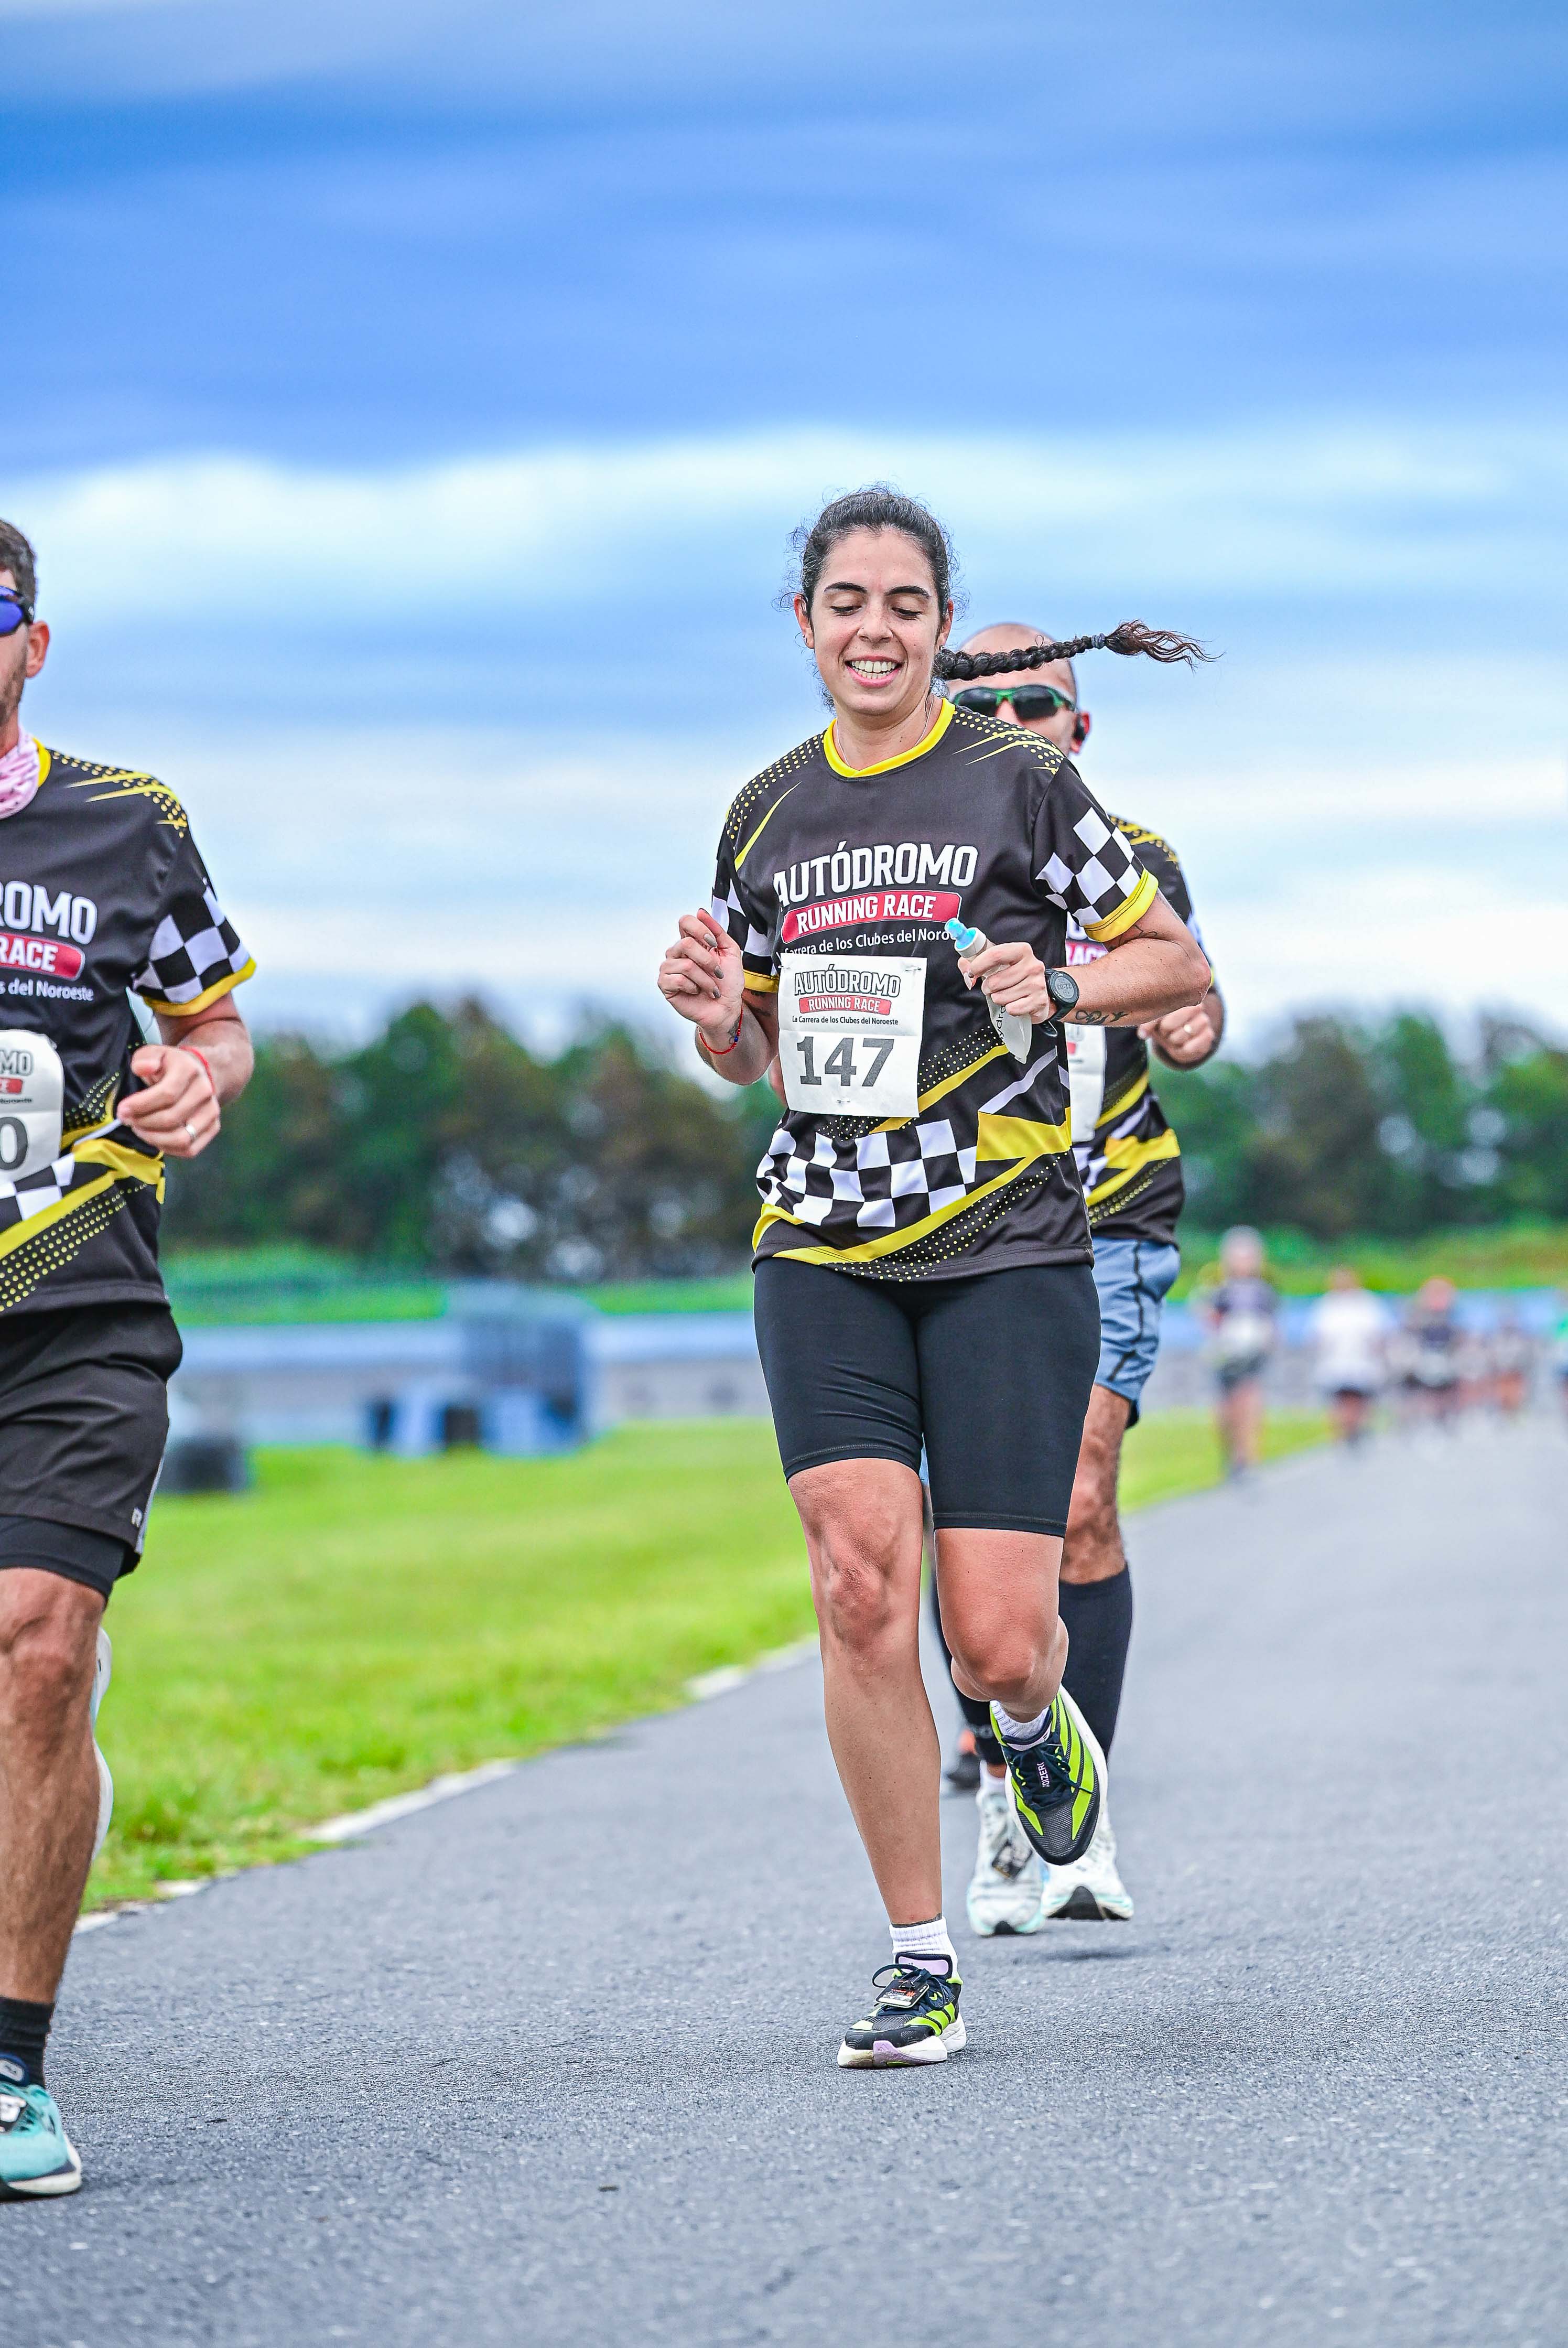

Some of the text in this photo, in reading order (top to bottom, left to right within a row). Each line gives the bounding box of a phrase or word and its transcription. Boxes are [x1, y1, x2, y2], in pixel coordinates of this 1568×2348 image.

[773, 841, 978, 912] AUTÓDROMO
[0, 880, 98, 944] OMO
[796, 894, 937, 935] RUNNING RACE
[819, 939, 834, 953] de
[836, 937, 853, 950] los
[856, 932, 894, 948] Clubes
[896, 928, 915, 943] del
[8, 977, 34, 996] del
[36, 980, 94, 1001] Noroeste
[794, 964, 901, 997] AUTÓDROMO
[808, 996, 881, 1013] RUNNING RACE
[797, 1036, 894, 1087] 147
[0, 1116, 28, 1170] 0
